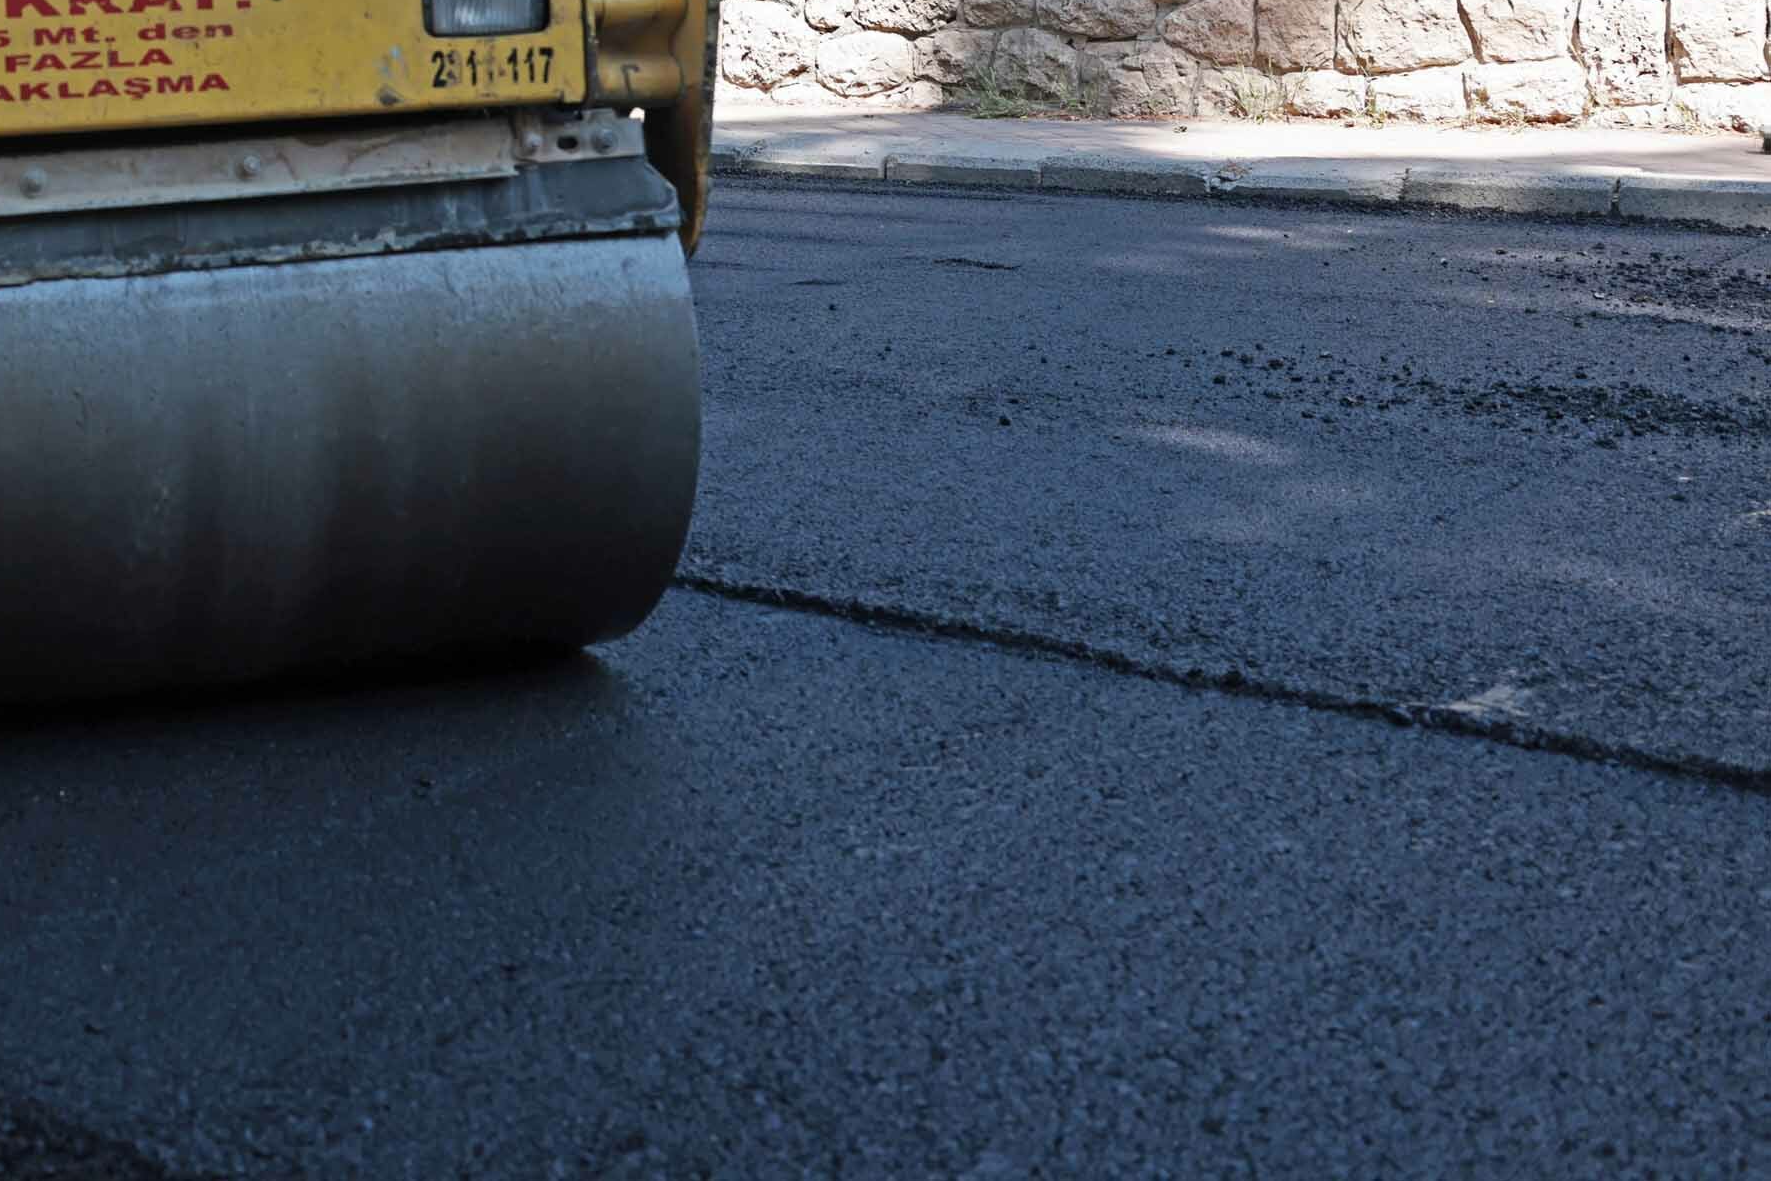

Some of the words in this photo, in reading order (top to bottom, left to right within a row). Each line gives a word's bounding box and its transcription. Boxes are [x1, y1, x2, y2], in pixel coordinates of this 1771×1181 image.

[33, 26, 116, 47] Mt.
[137, 23, 234, 42] den
[4, 48, 173, 73] FAZLA
